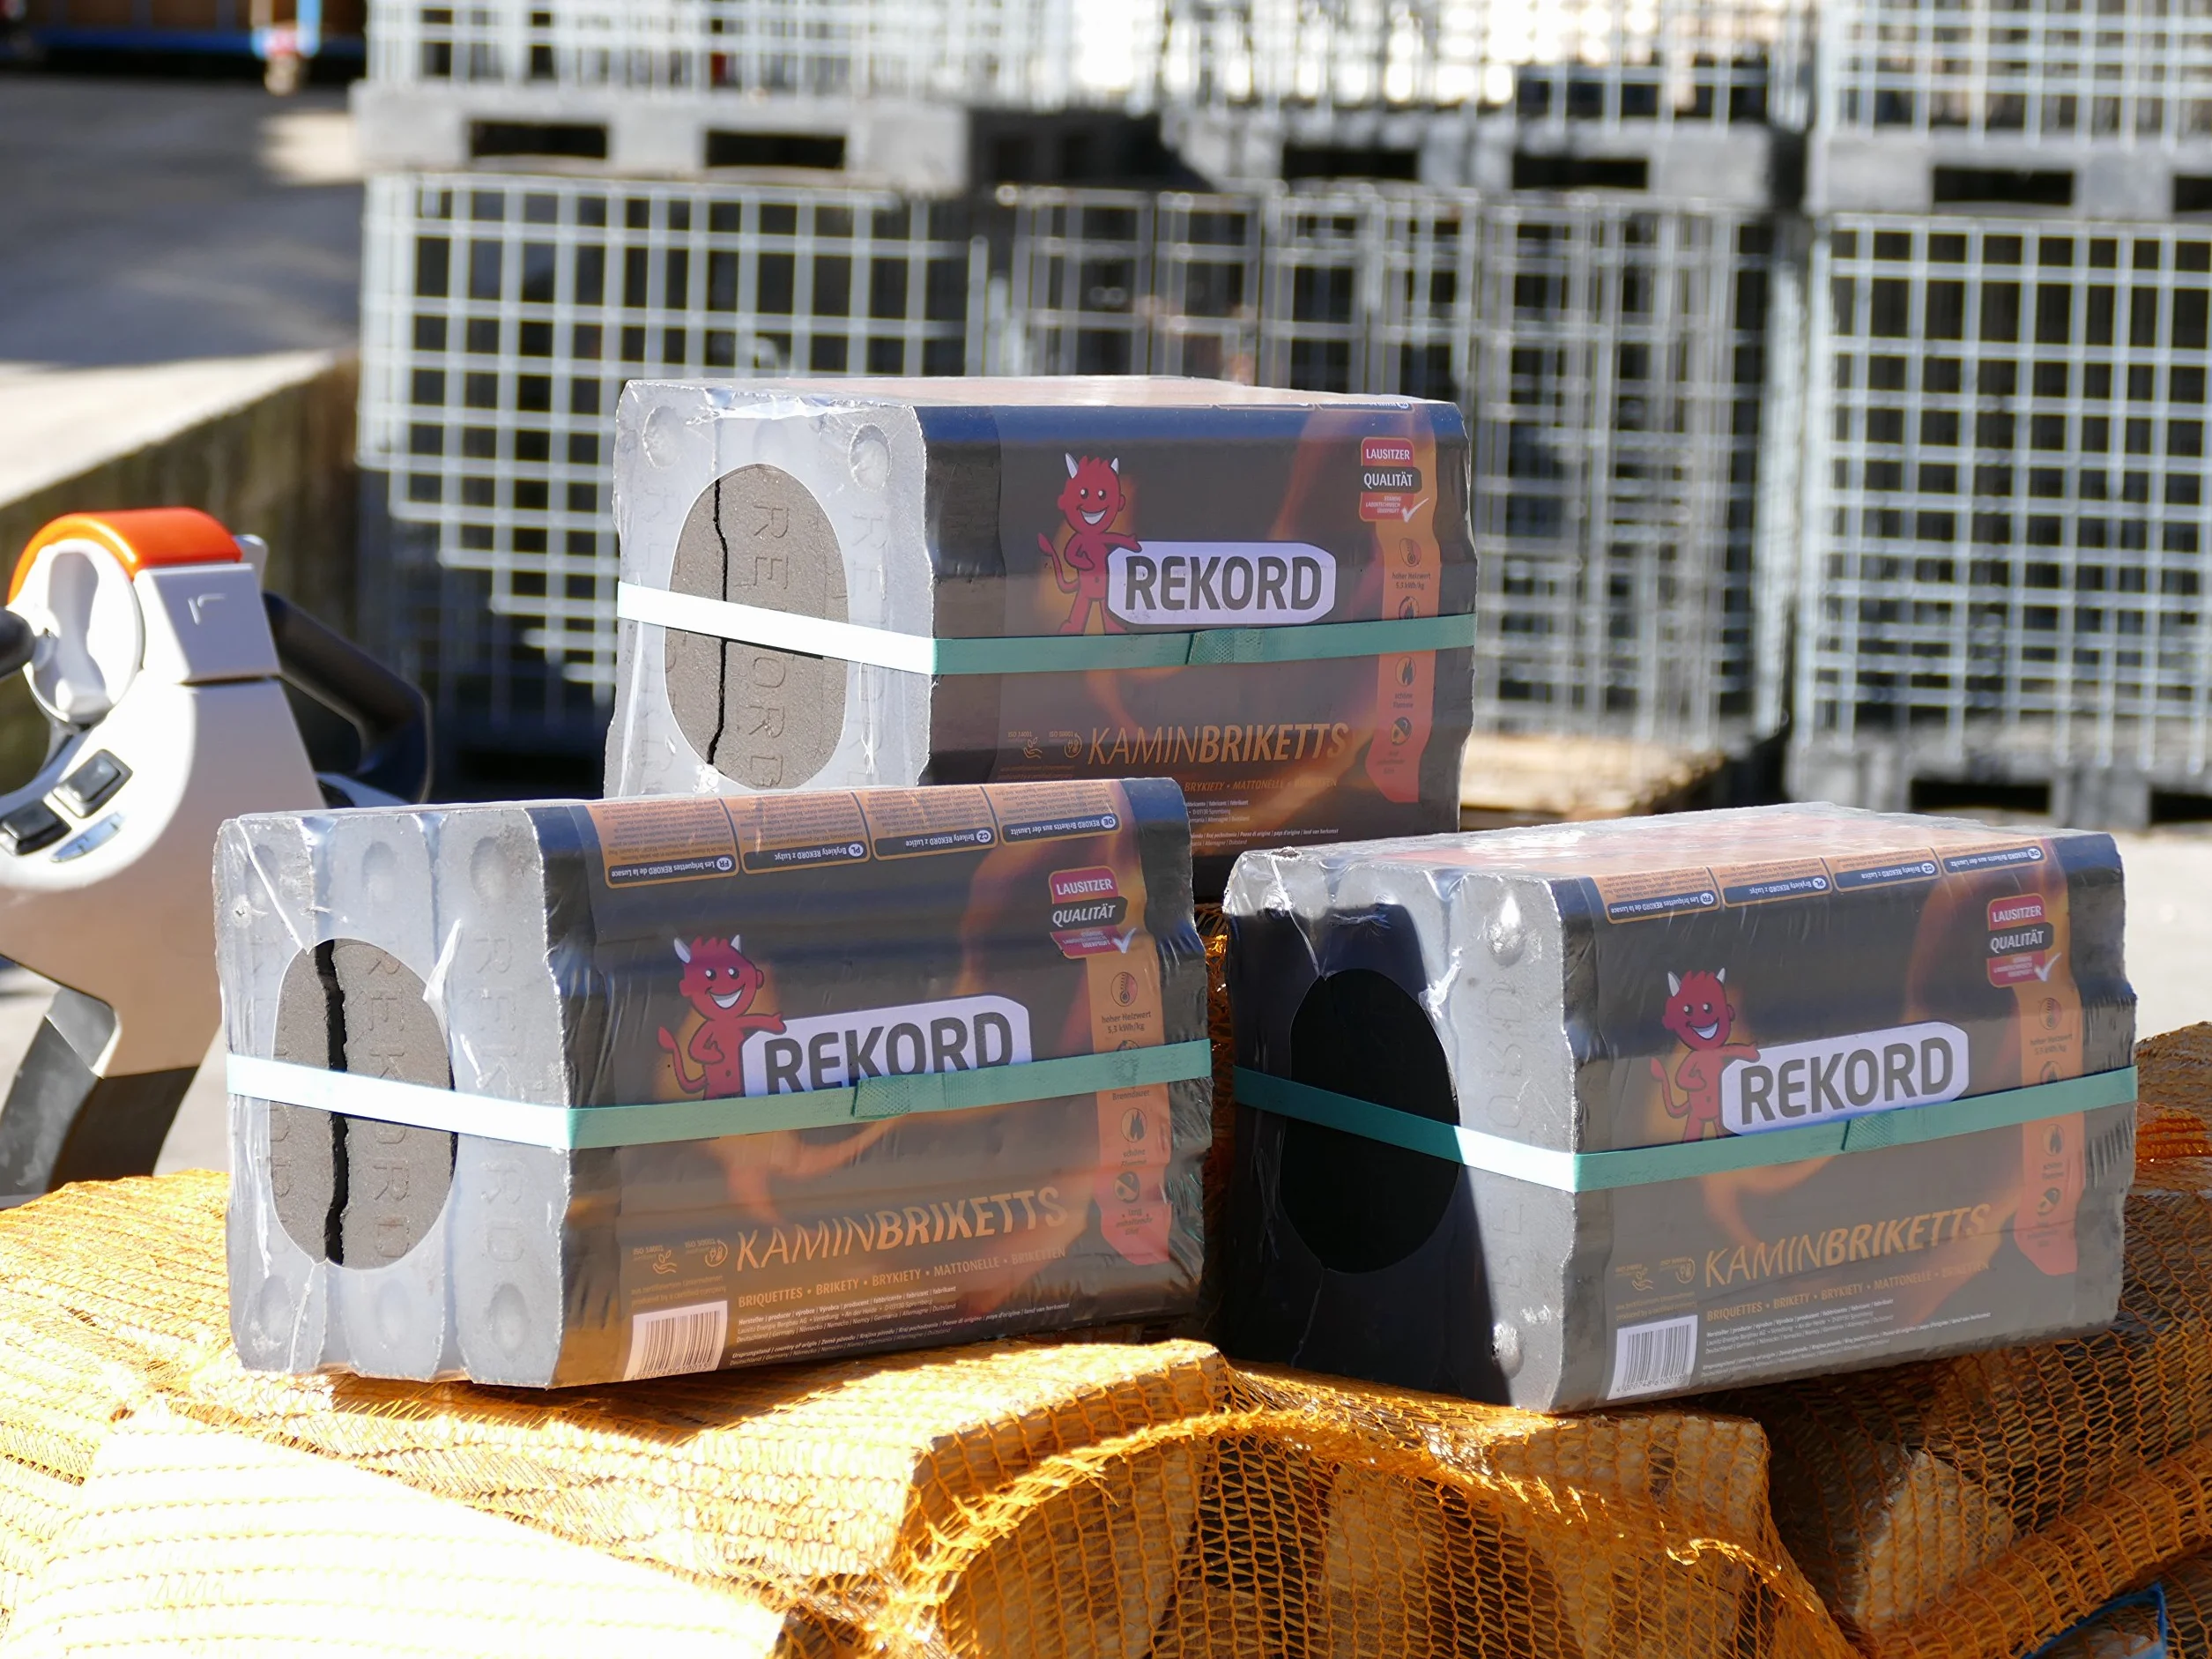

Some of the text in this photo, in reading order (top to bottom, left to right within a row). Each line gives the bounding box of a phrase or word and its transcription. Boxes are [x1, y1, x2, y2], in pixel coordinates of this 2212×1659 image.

[1366, 448, 1410, 460] LAUSITZER
[1363, 472, 1413, 489] QUALITÄT
[1125, 554, 1323, 612] REKORD
[1087, 721, 1350, 765] KAMINBRIKETTS
[1184, 782, 1225, 792] BRYKIETY
[1010, 827, 1032, 836] Lausitz
[1077, 820, 1101, 829] REKORD
[929, 836, 953, 845] REKORD
[953, 833, 975, 842] Brikety
[797, 849, 821, 859] REKORD
[821, 846, 847, 856] Brykiety
[850, 846, 861, 855] PL
[648, 865, 673, 875] REKORD
[673, 863, 705, 872] briquettes
[1056, 878, 1114, 896] LAUSITZER
[1052, 904, 1117, 927] QUALITÄT
[1992, 904, 2043, 923] LAUSITZER
[1989, 928, 2045, 954] QUALITÄT
[1102, 1011, 1152, 1024] hoher Heizwert
[1108, 1023, 1145, 1035] 5,3 kWh/kg
[763, 1011, 1015, 1094] REKORD
[1740, 1037, 1955, 1126] REKORD
[736, 1186, 1069, 1271] KAMINBRIKETTS
[1704, 1203, 1992, 1289] KAMINBRIKETTS
[739, 1287, 803, 1307] BRIQUETTES
[815, 1278, 860, 1296] BRIKETY
[872, 1268, 921, 1287] BRYKIETY
[934, 1256, 1000, 1277] MATTONELLE
[1707, 1301, 1763, 1321] BRIQUETTES
[1773, 1292, 1811, 1310] BRIKETY
[1821, 1283, 1864, 1301] BRYKIETY
[1874, 1270, 1932, 1291] MATTONELLE
[739, 1315, 764, 1326] Hersteller
[768, 1312, 791, 1322] producer
[843, 1299, 870, 1310] producent
